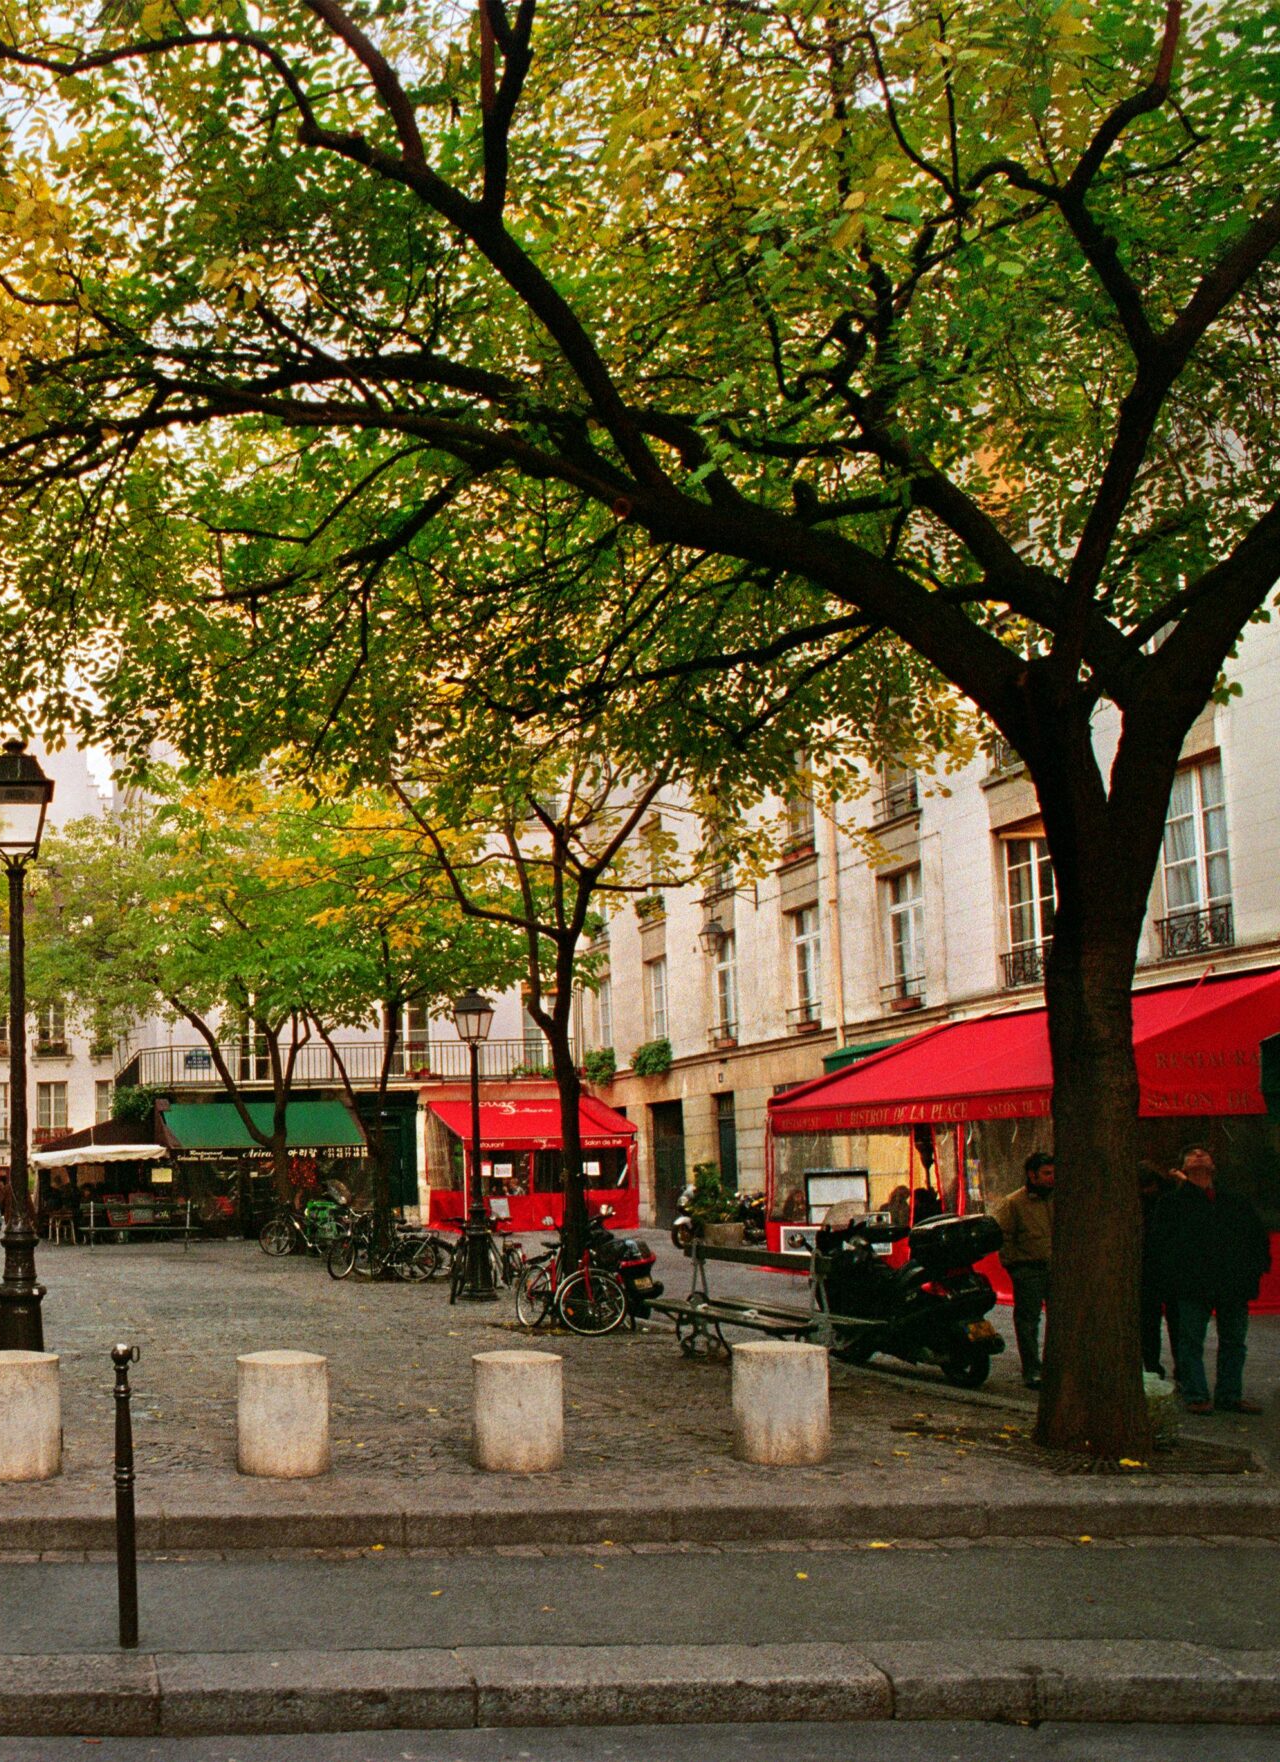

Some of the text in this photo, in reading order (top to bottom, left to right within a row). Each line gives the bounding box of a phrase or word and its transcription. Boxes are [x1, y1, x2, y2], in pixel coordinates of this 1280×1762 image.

[850, 1108, 890, 1125] BISTROT
[910, 1104, 925, 1121] LA
[931, 1102, 968, 1119] PLACE
[242, 1148, 274, 1159] Arira
